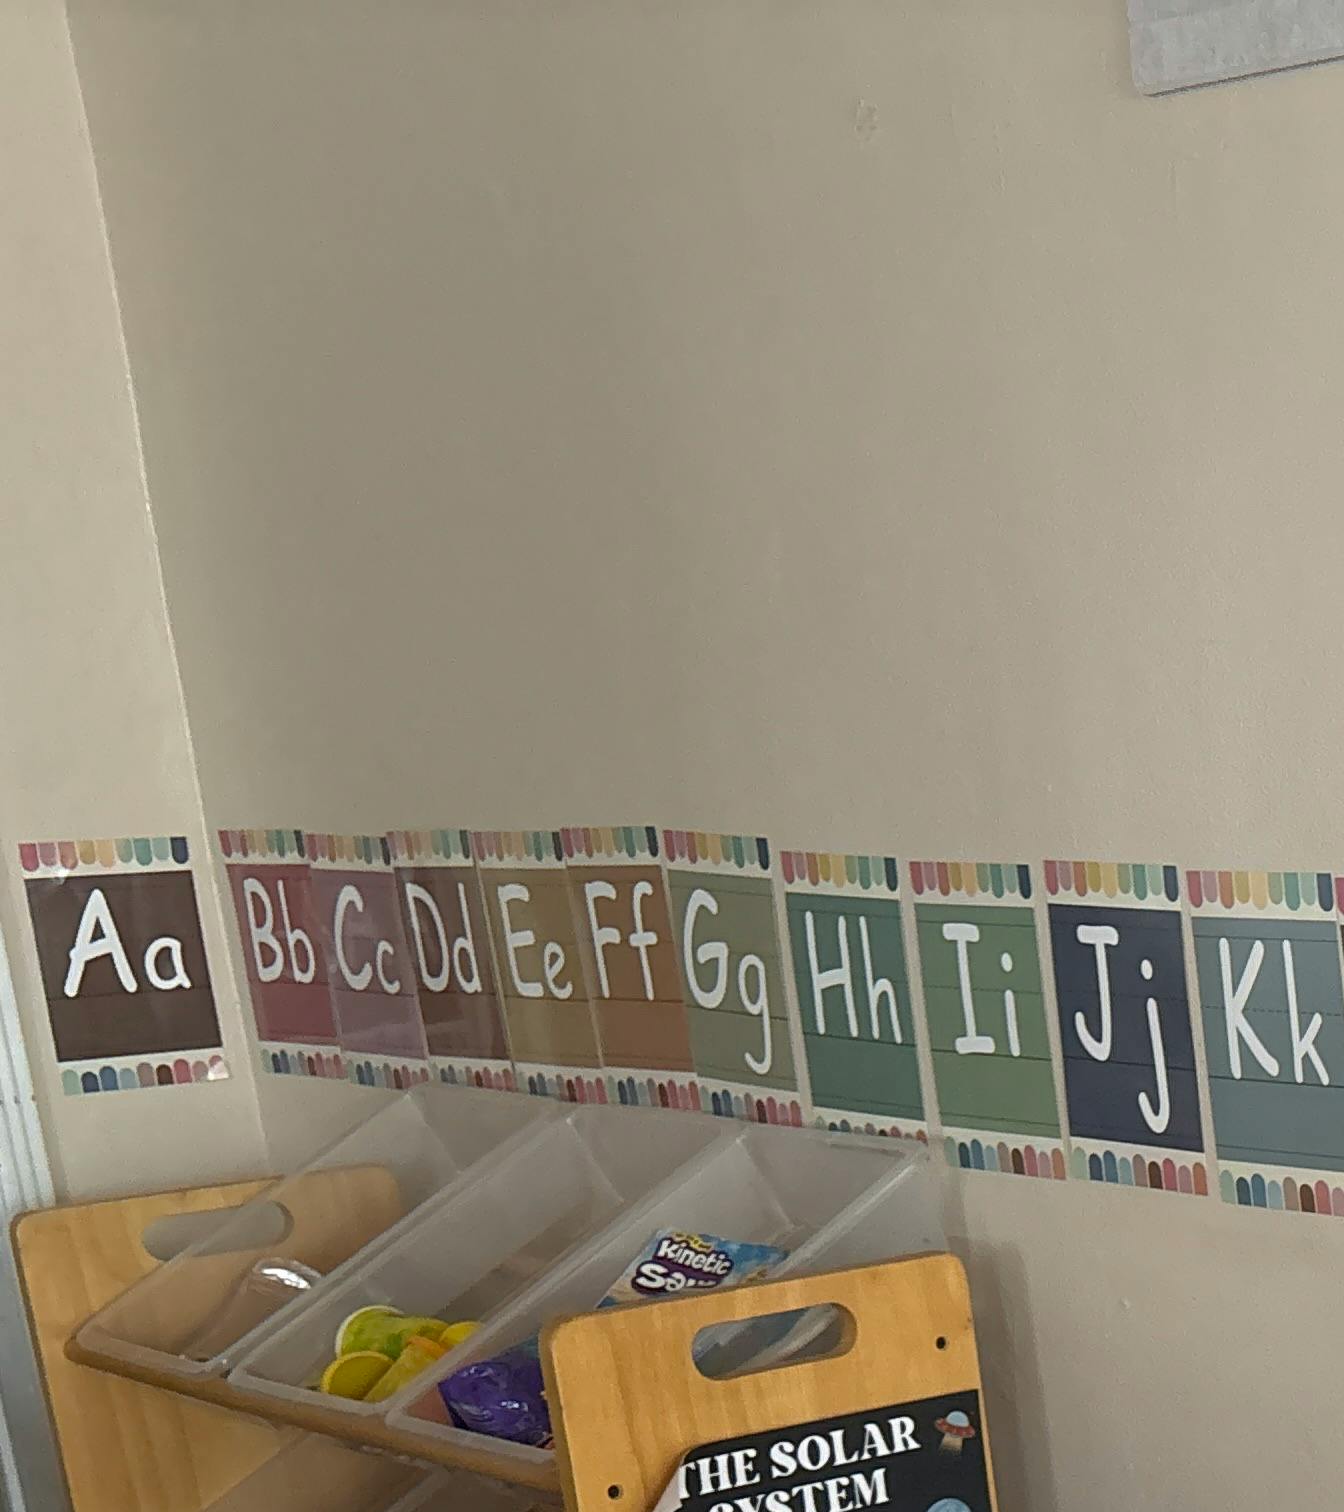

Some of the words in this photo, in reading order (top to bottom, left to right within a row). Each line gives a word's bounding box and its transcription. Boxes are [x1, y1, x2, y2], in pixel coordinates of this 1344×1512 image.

[63, 889, 191, 998] Aa
[243, 877, 315, 984] Bb
[333, 884, 400, 995] Cc
[405, 881, 482, 995] Dd
[497, 884, 573, 1000] Ee
[586, 881, 658, 1000] Ff
[683, 889, 772, 1075] Gg
[805, 911, 902, 1044] Hh
[942, 923, 1021, 1057] Ii
[1074, 924, 1169, 1134] Jj
[1219, 937, 1329, 1086] Kk
[636, 1264, 718, 1291] Sa
[658, 1240, 731, 1275] Kinetic
[678, 1448, 761, 1501] THE
[771, 1415, 921, 1480] SOLAR
